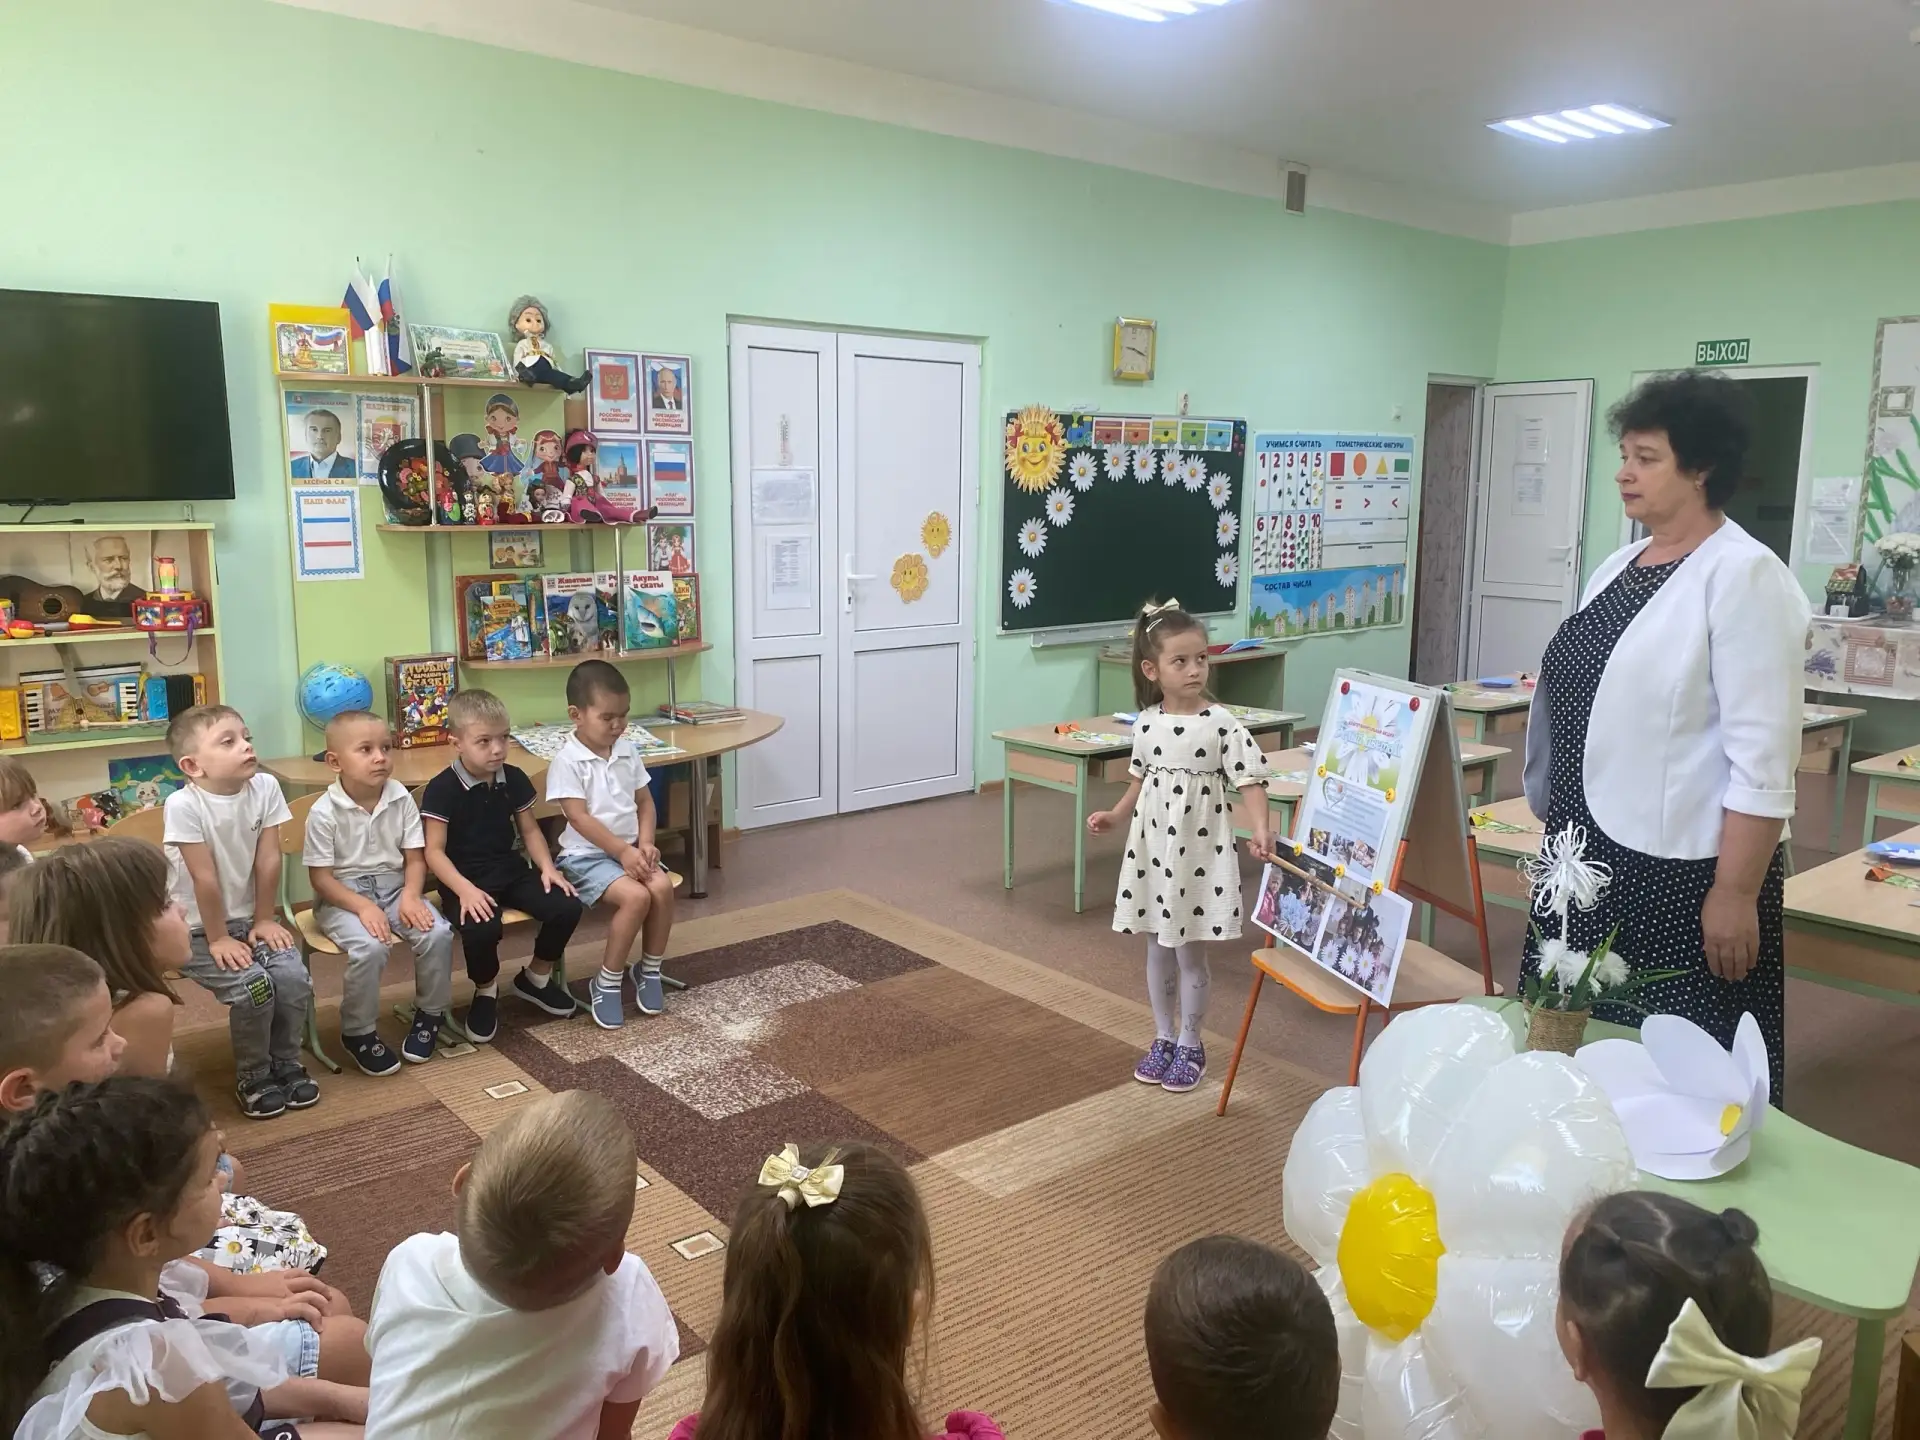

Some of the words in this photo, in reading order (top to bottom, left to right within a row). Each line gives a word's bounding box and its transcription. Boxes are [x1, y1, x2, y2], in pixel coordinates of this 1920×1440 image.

[1697, 341, 1748, 362] ВЫХОД
[1266, 440, 1293, 448] УЧИМСЯ
[1295, 440, 1322, 448] СЧИТАТЬ
[1335, 440, 1383, 448] ГЕОМЕТРИЧЕСКИЕ
[1383, 441, 1405, 449] ФИГУРЫ
[1259, 452, 1266, 468] 1
[1273, 452, 1281, 468] 2
[1286, 452, 1294, 468] 3
[1300, 452, 1308, 467] 4
[1314, 452, 1322, 467] 5
[1256, 516, 1264, 532] 6
[1271, 515, 1279, 531] 7
[1285, 514, 1292, 530] 8
[1299, 514, 1306, 529] 9
[1311, 513, 1321, 528] 10
[632, 574, 660, 583] Акулы
[640, 581, 664, 589] скаты
[1264, 580, 1291, 591] СОСТАВ
[1293, 579, 1312, 588] ЧИСЛА
